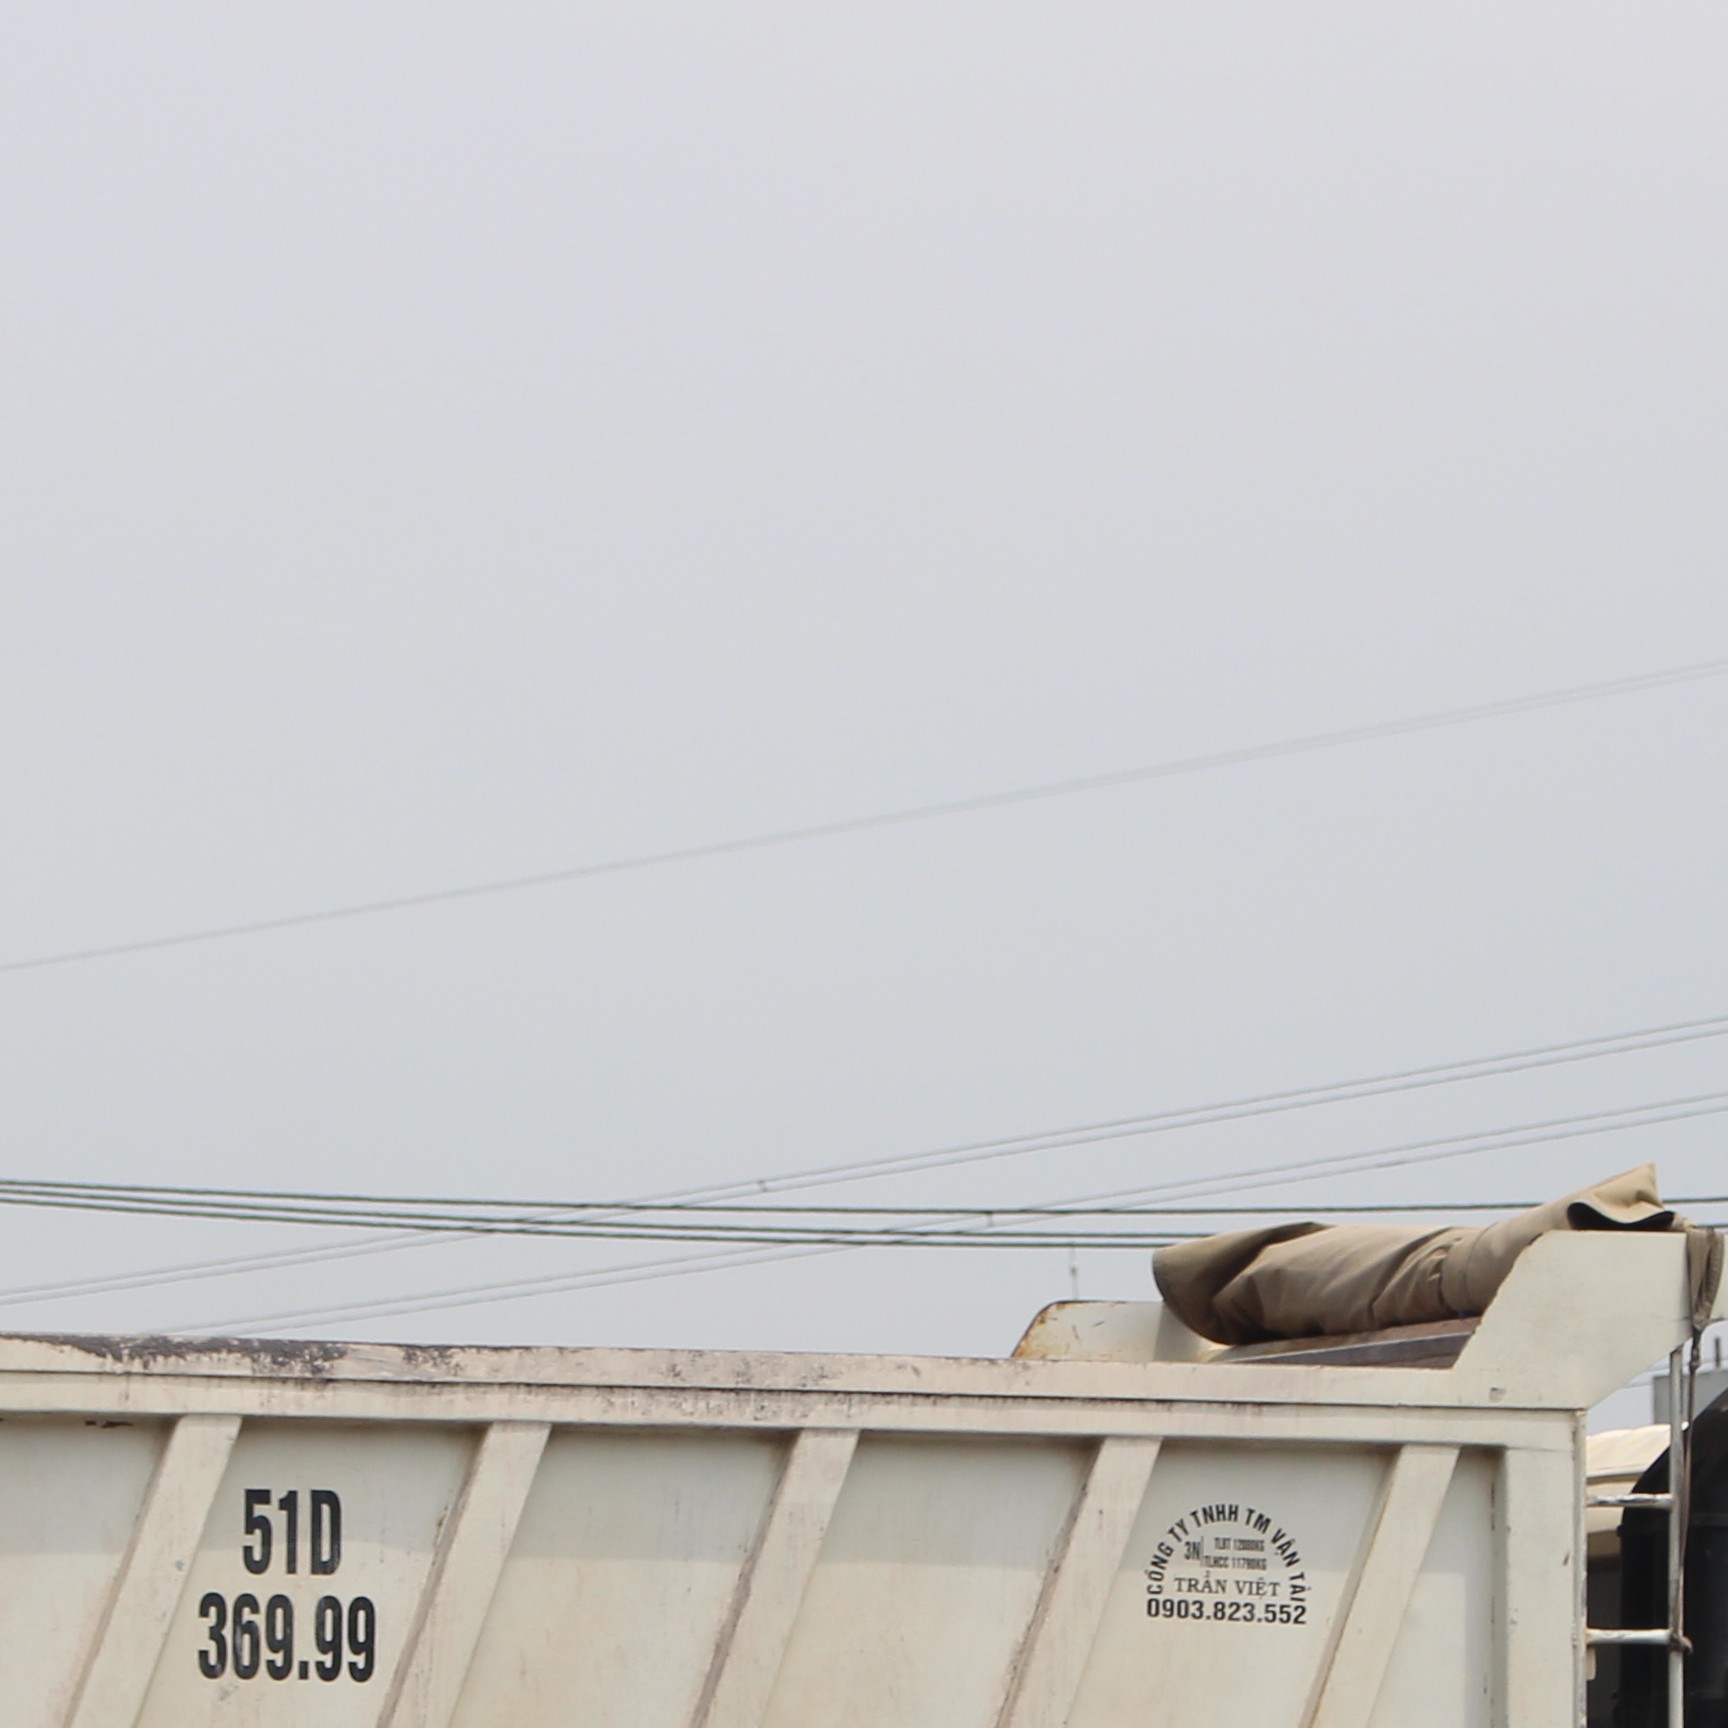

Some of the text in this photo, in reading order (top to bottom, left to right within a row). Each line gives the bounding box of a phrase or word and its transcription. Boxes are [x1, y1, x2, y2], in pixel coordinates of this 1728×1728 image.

[243, 1489, 342, 1575] 51D
[1144, 1541, 1175, 1595] CÔNG
[1167, 1518, 1189, 1543] TY
[1190, 1503, 1239, 1528] TNHH
[1245, 1508, 1271, 1534] TM
[198, 1592, 376, 1682] 369.99
[1147, 1597, 1307, 1625] 0903.823.552
